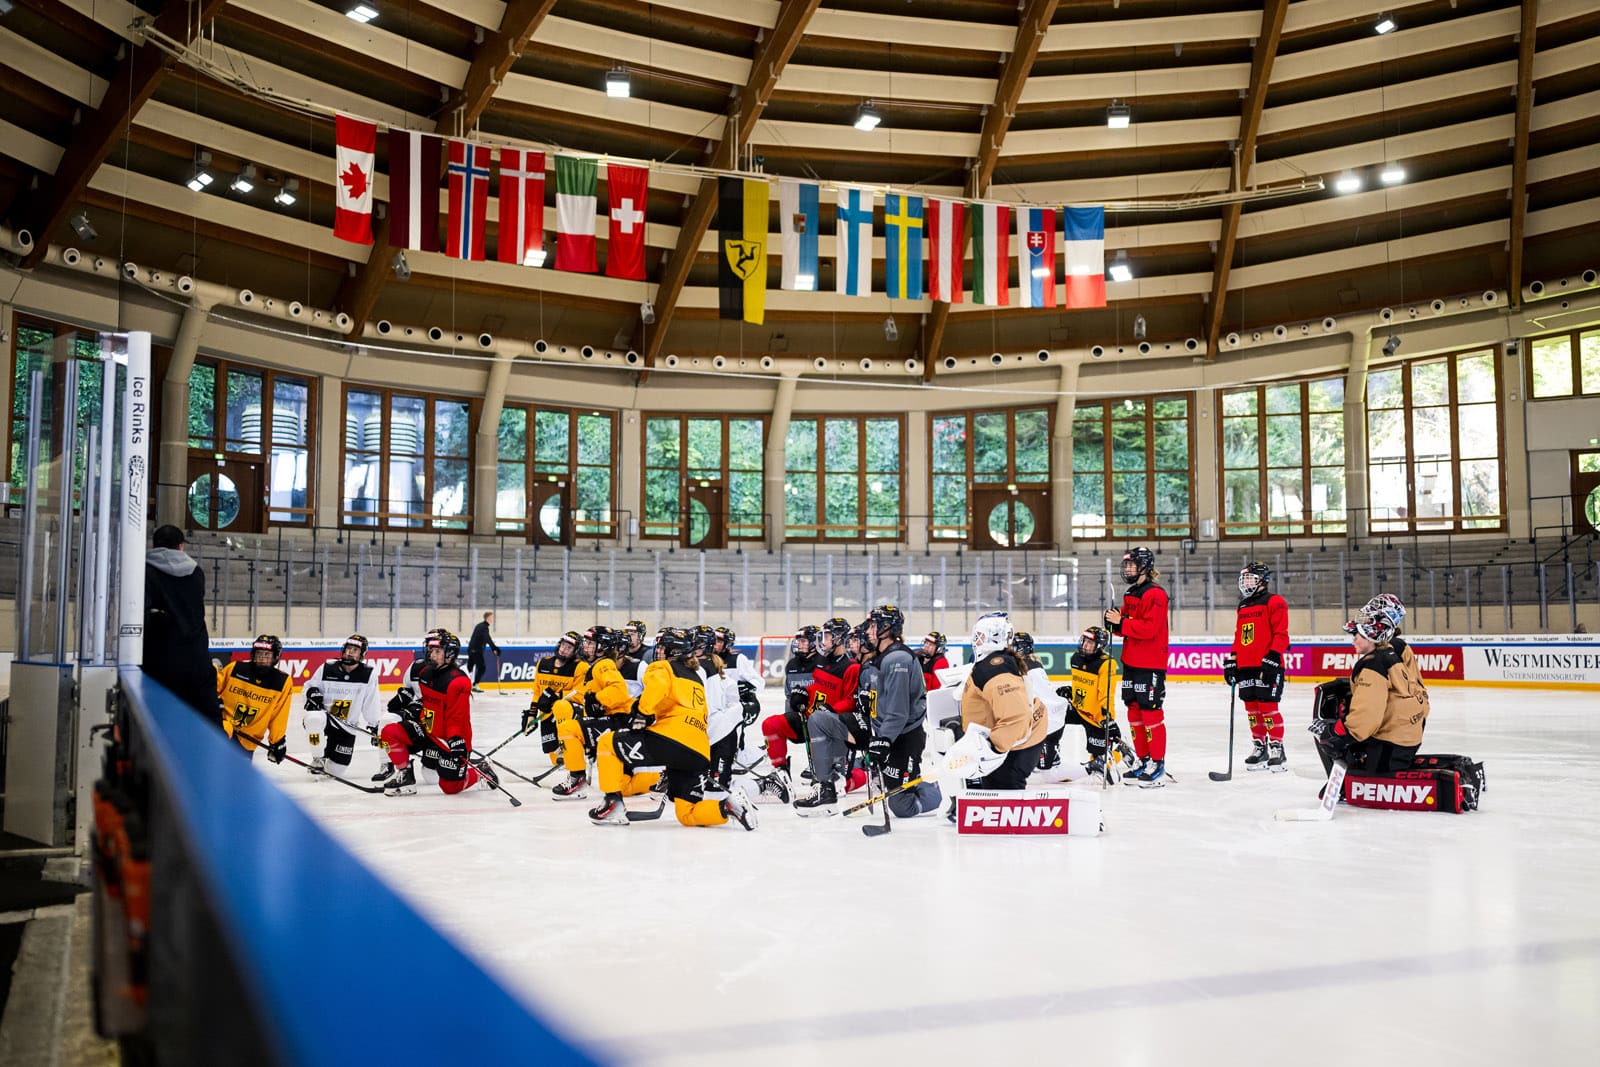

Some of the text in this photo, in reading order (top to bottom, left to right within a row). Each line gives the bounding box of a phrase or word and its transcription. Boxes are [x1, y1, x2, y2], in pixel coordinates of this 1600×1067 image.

[132, 376, 145, 444] Ice Rinks
[1395, 771, 1432, 779] CCM
[963, 805, 1064, 828] PENNY.
